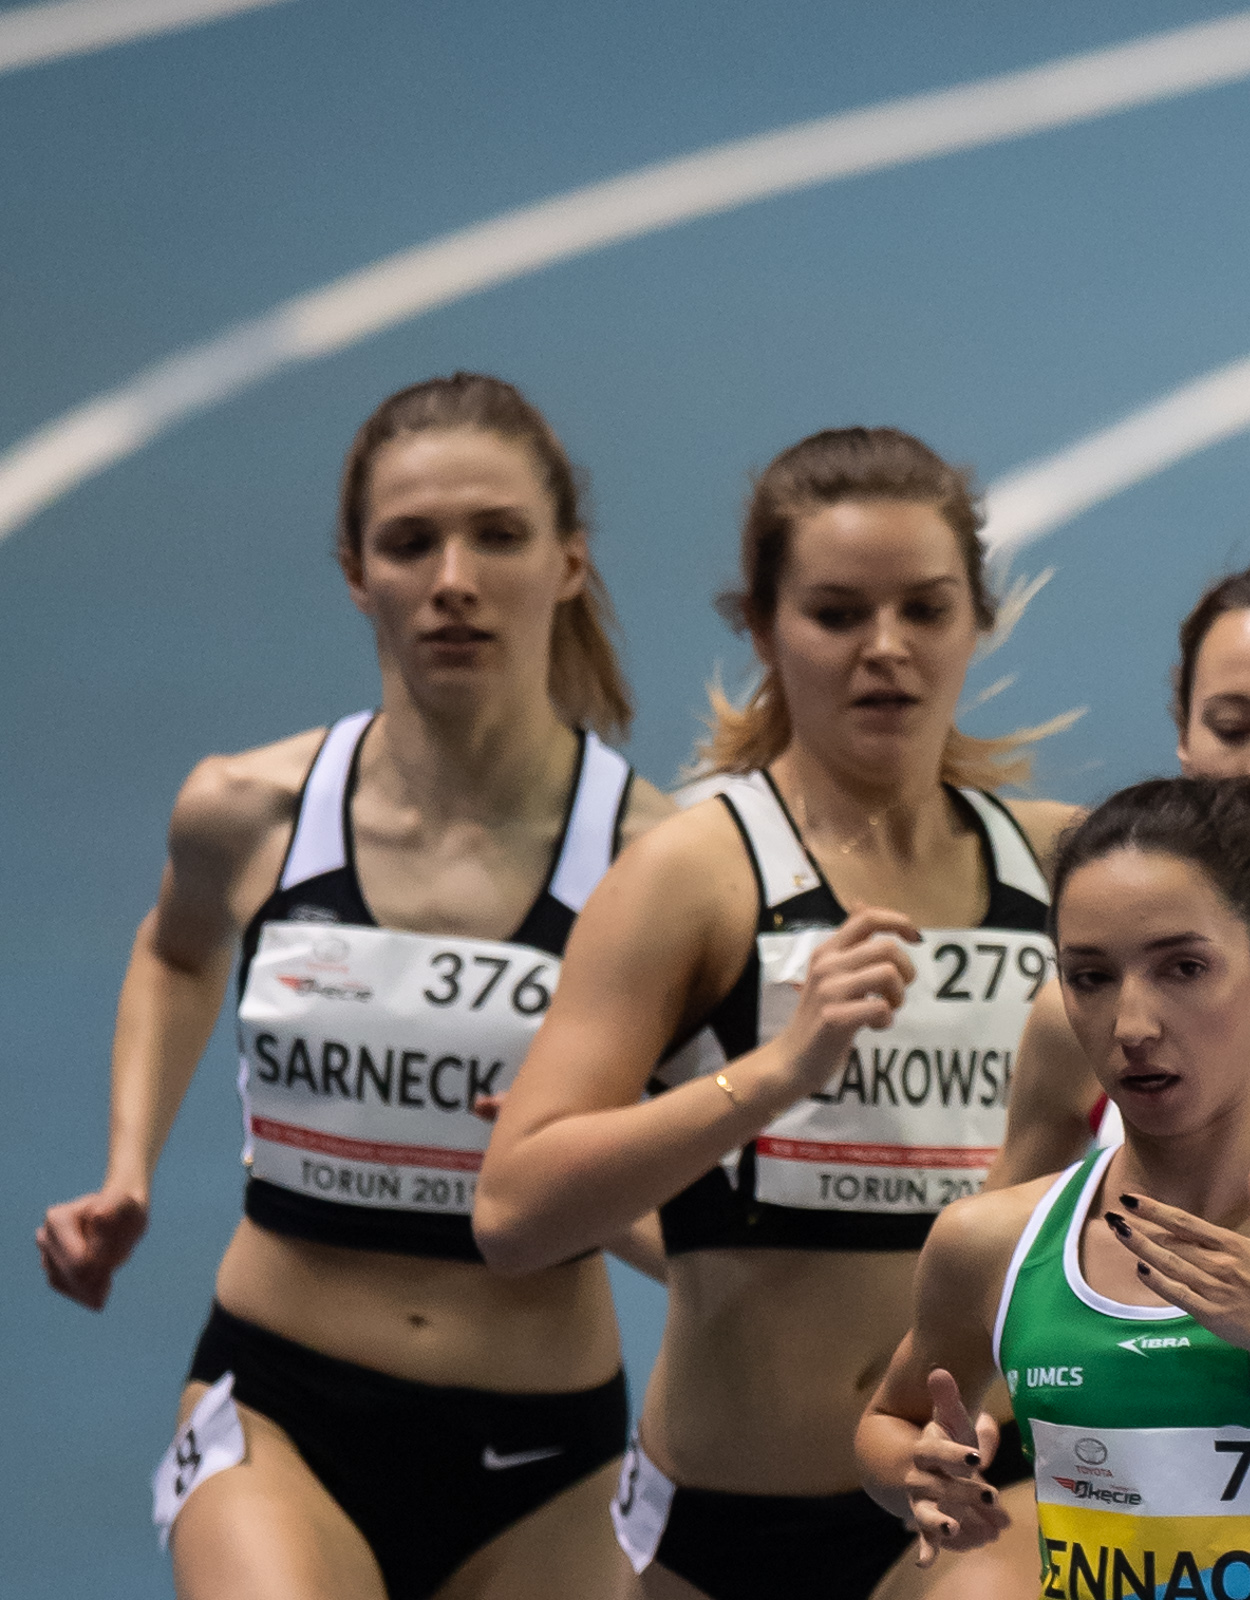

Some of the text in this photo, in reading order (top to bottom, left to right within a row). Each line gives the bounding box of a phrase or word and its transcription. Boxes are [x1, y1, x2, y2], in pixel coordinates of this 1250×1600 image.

[424, 952, 552, 1016] 376
[934, 943, 1045, 1002] 279
[255, 1033, 506, 1115] SARNECK
[811, 1048, 1012, 1107] AKOWS
[413, 1176, 477, 1205] 201
[1026, 1366, 1084, 1388] UMCS
[1075, 1465, 1114, 1478] TOYOTA
